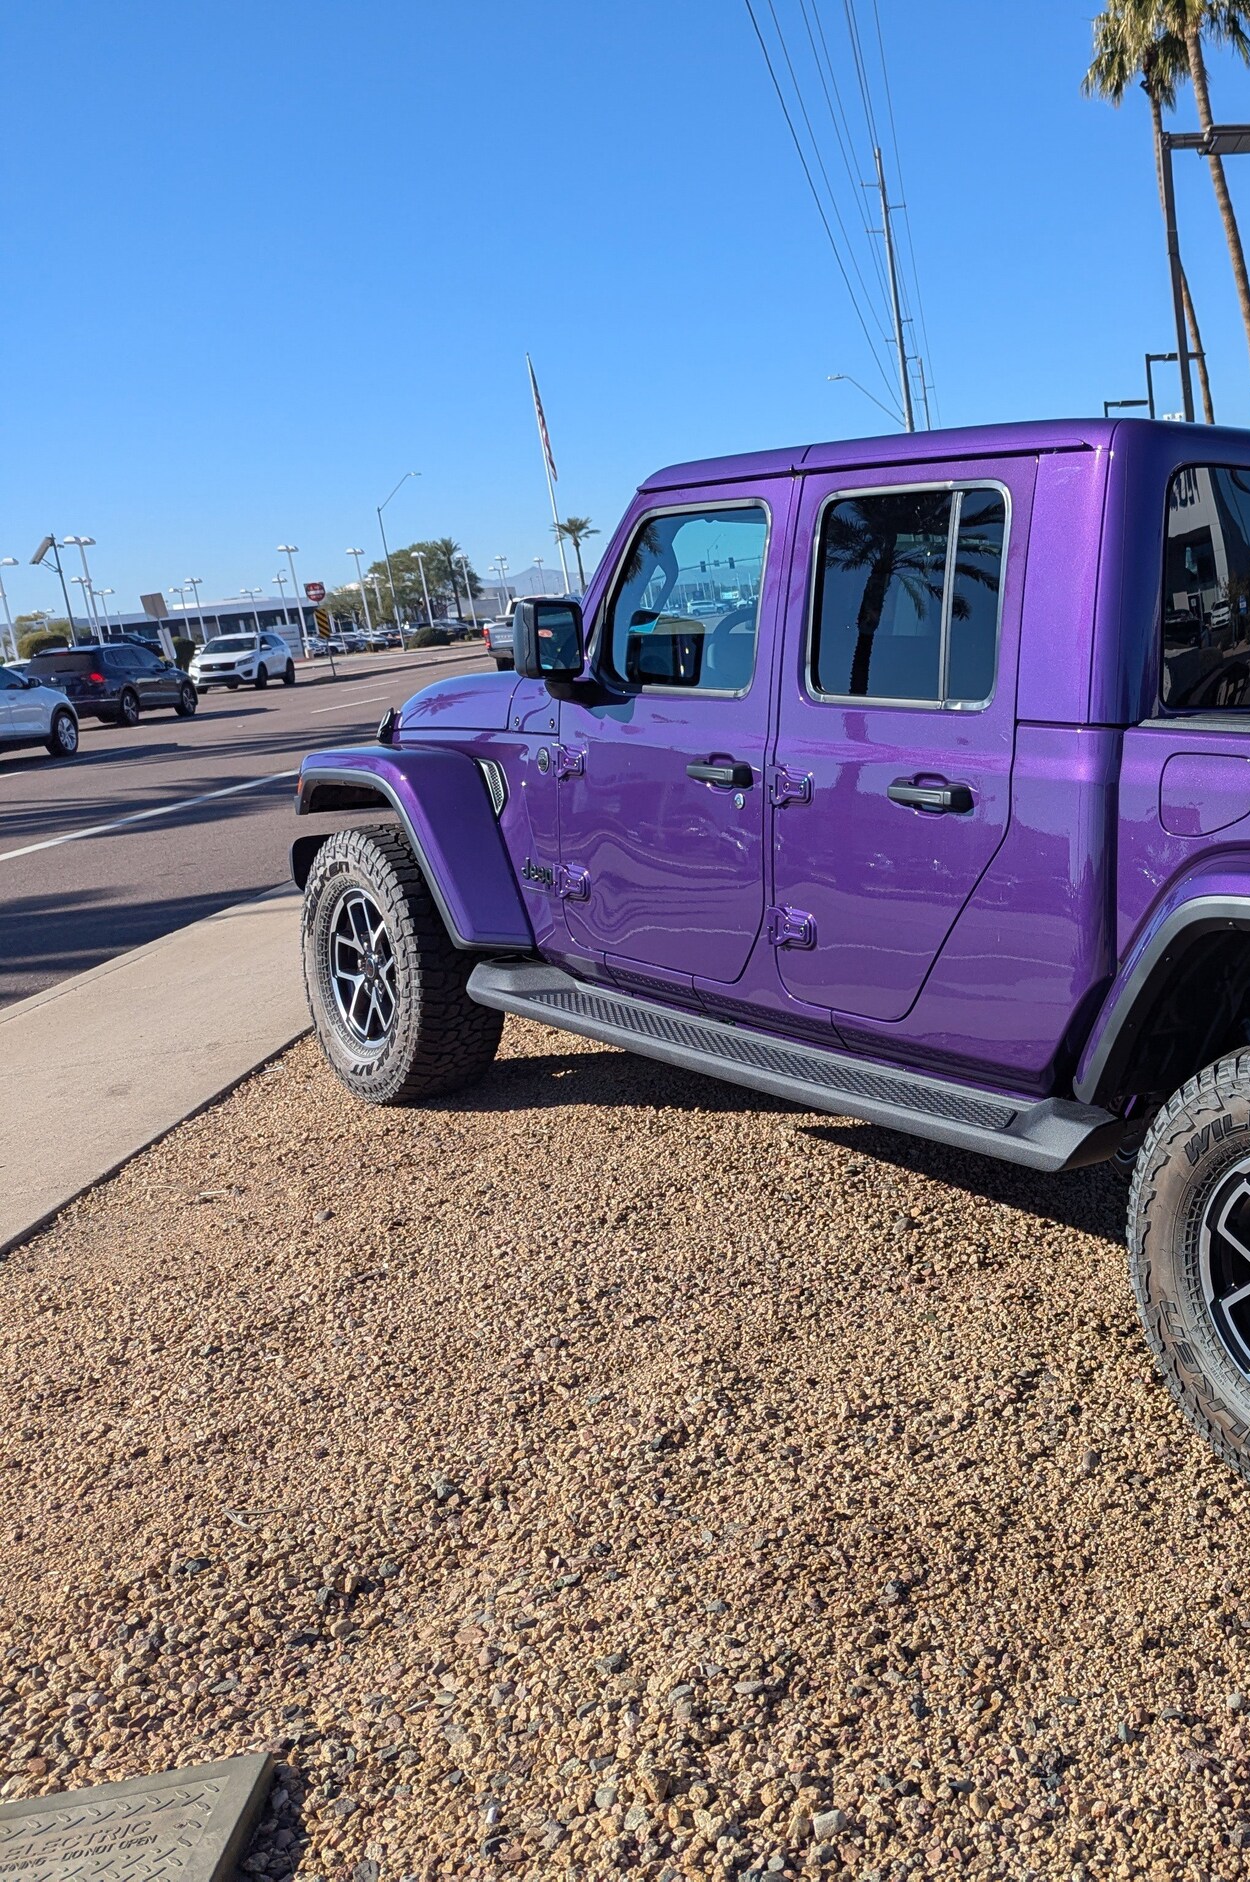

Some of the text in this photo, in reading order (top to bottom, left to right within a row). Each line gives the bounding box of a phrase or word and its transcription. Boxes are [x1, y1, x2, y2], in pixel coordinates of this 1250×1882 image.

[521, 857, 554, 890] Jeep
[4, 1820, 152, 1861] ELECTRIC
[119, 1834, 158, 1850] OPEN
